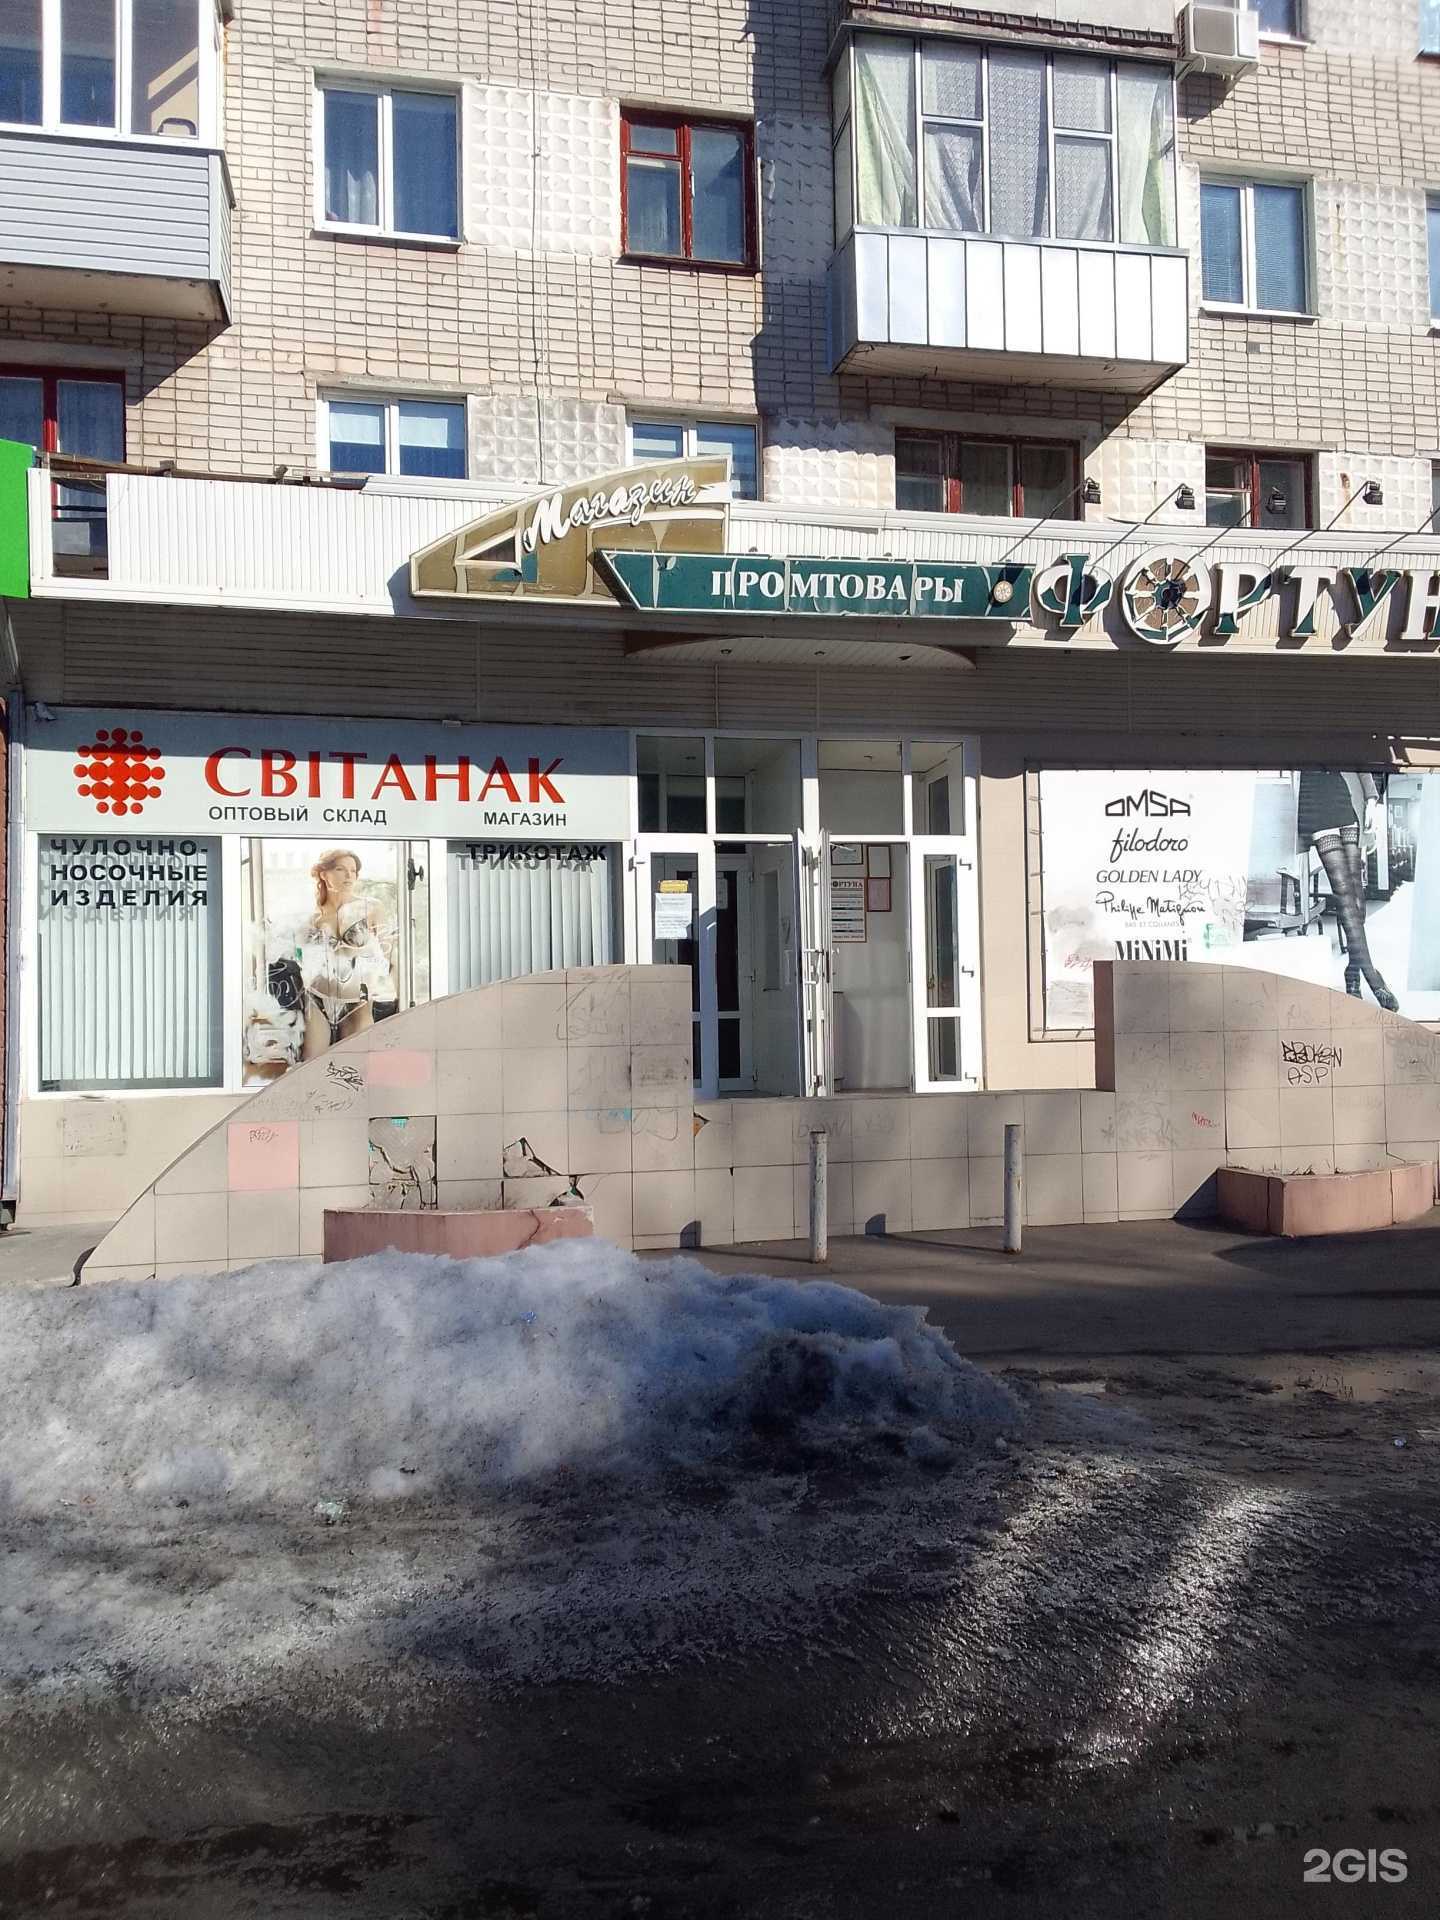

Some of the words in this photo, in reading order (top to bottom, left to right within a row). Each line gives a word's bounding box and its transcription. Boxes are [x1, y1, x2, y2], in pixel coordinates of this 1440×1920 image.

[522, 474, 697, 553] Магазин
[711, 570, 966, 603] ПРОМТОВАРЫ
[204, 746, 566, 804] СВІТАНАК
[1105, 789, 1191, 817] OMSA
[208, 804, 309, 823] ОПТОВЫЙ
[322, 808, 387, 826] СКЛАД
[483, 811, 567, 827] МАГАЗИН
[50, 839, 208, 856] ЧУЛОЧНО-
[465, 843, 607, 861] ТРИКОТАЖ
[1109, 827, 1188, 863] filodoro
[50, 864, 208, 881] НОСОЧНЫЕ
[1096, 869, 1159, 883] GOLDEN
[1162, 869, 1202, 883] LADY
[50, 889, 208, 909] ИЗДЕЛИЯ
